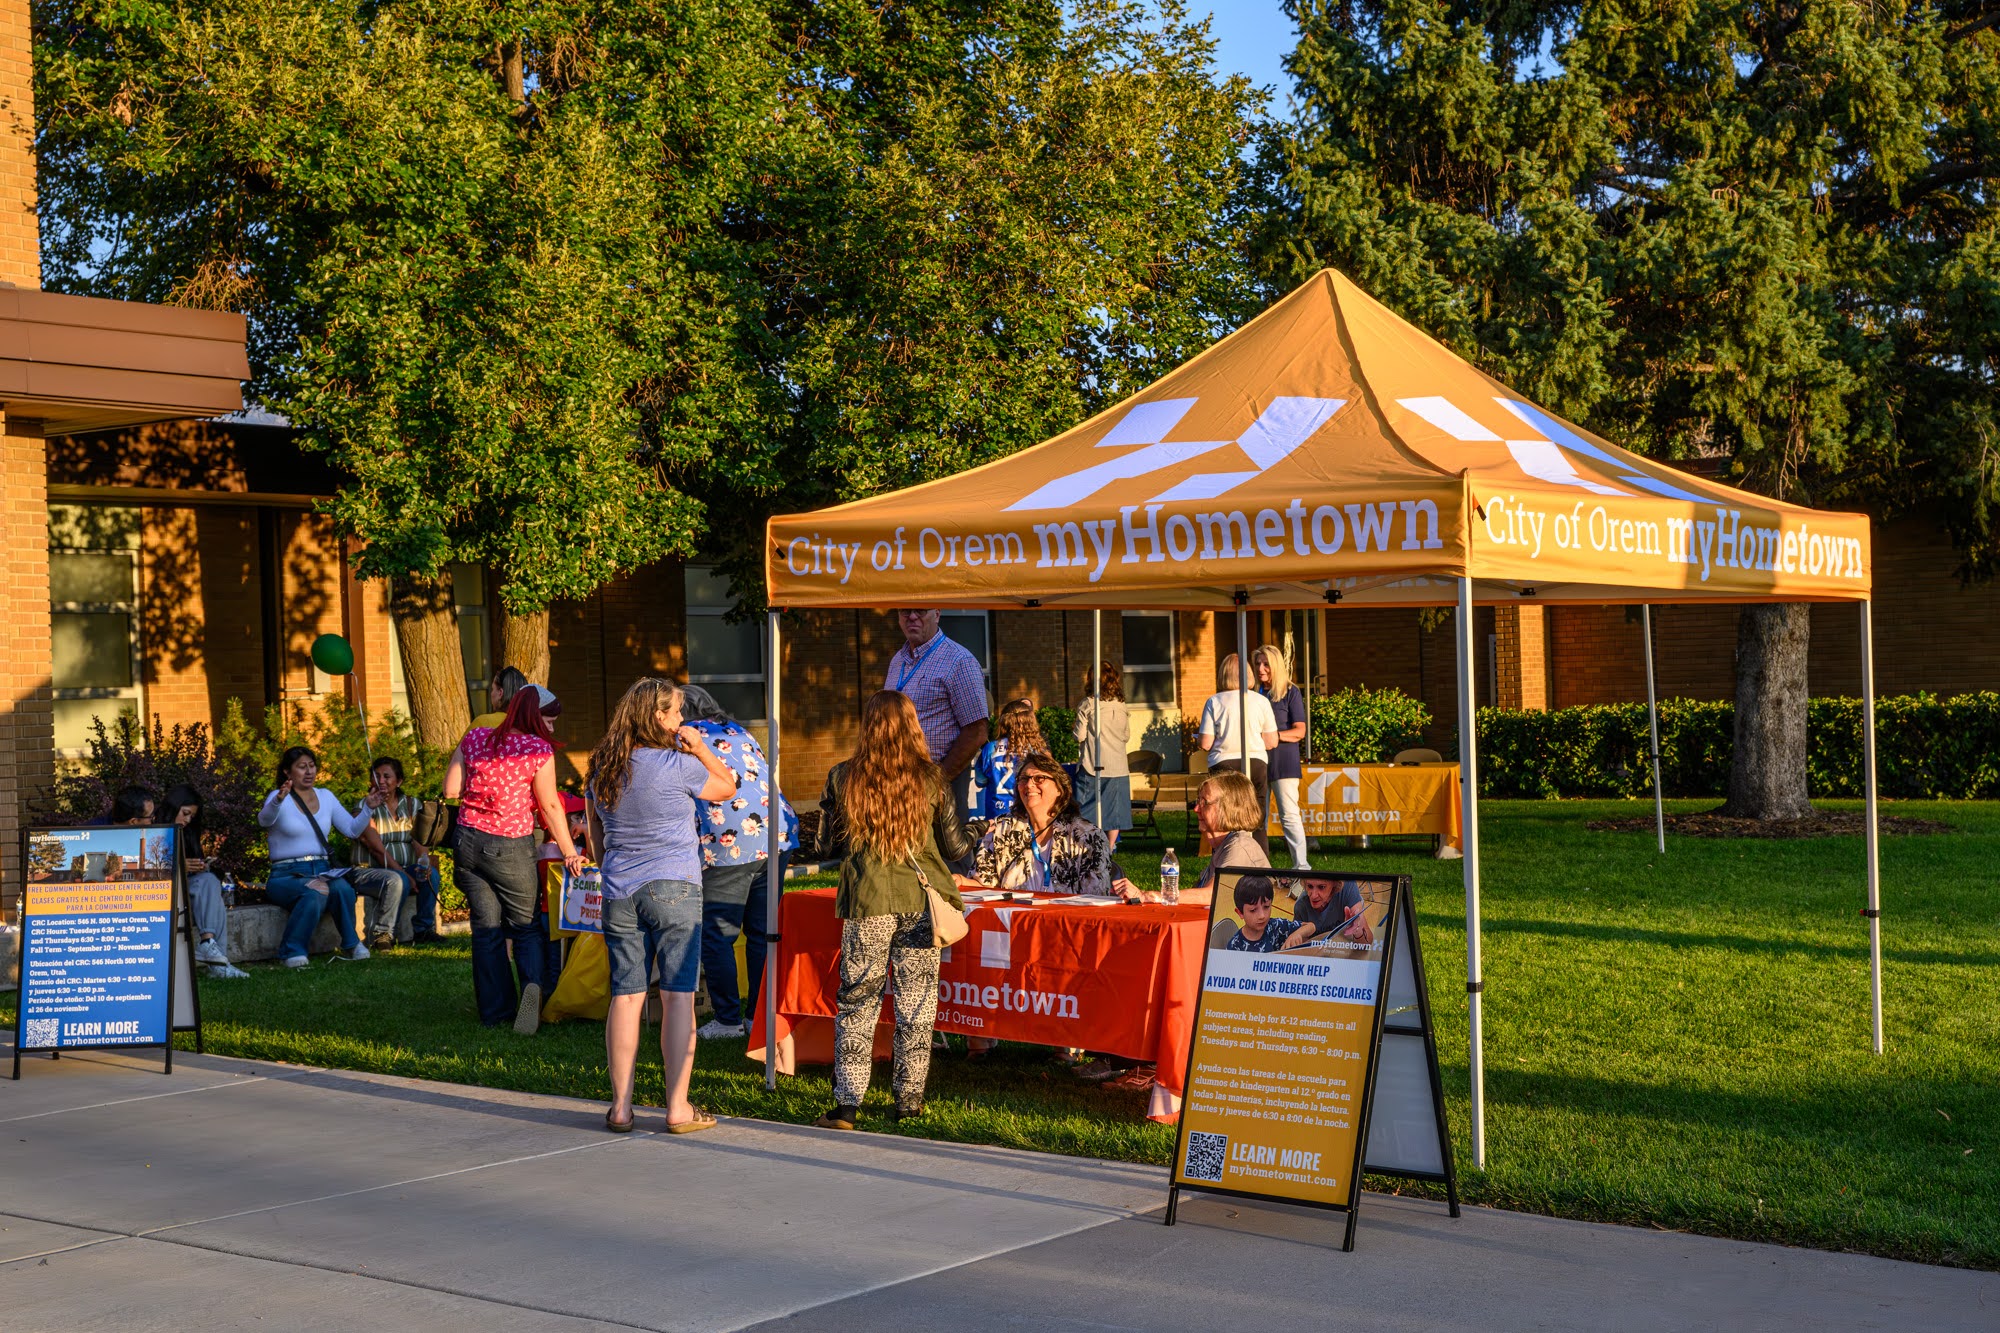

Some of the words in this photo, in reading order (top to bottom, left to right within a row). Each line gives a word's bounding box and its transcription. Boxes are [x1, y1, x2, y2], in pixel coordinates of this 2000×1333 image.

[786, 536, 862, 585] City
[871, 527, 906, 572] of
[918, 527, 1027, 568] Orem
[1033, 498, 1443, 582] myHometown
[1485, 495, 1546, 558] City
[1554, 500, 1585, 549] of
[1588, 505, 1662, 555] Orem
[1666, 508, 1863, 581] myHometown
[1272, 808, 1401, 824] Hometown
[29, 834, 80, 843] myHometown
[144, 882, 170, 890] CLASSES
[585, 893, 602, 905] HUNT
[68, 945, 103, 953] September
[1311, 938, 1371, 951] myHometown
[1253, 961, 1304, 975] HOMEWORK
[1307, 965, 1330, 977] HELP
[115, 994, 152, 1002] septiembre
[938, 976, 1081, 1020] ometown
[1207, 976, 1235, 988] AYUDA
[1239, 978, 1257, 990] CON
[1260, 980, 1276, 992] LOS
[1279, 982, 1318, 996] DEBERES
[1321, 985, 1372, 1000] ESCOLARES
[64, 1023, 101, 1036] LEARN
[106, 1021, 139, 1034] MORE
[938, 1008, 951, 1022] of
[952, 1010, 985, 1028] Orem
[1205, 1009, 1246, 1020] Homework
[1248, 1013, 1266, 1024] help
[1267, 1014, 1279, 1023] for
[1280, 1016, 1298, 1025] K-12
[1300, 1019, 1334, 1029] students
[1346, 1022, 1356, 1030] all
[64, 1036, 153, 1046] myhometownut.com
[1203, 1023, 1231, 1033] subject
[1232, 1027, 1254, 1036] areas,
[1257, 1028, 1294, 1041] including
[1296, 1032, 1327, 1044] reading.
[1202, 1036, 1238, 1048] Tuesdays
[1239, 1040, 1254, 1048] and
[1256, 1041, 1299, 1054] Thursdays,
[1302, 1046, 1318, 1055] 6:30
[1326, 1048, 1343, 1057] 8:00
[1344, 1052, 1362, 1060] p.m.
[1197, 1063, 1222, 1072] Ayuda
[1238, 1067, 1250, 1076] las
[1252, 1069, 1275, 1079] tareas
[1276, 1071, 1287, 1080] de
[1288, 1072, 1296, 1080] la
[1297, 1075, 1327, 1084] escuela
[1328, 1078, 1346, 1086] para
[1195, 1076, 1228, 1087] alumnos
[1229, 1080, 1238, 1088] de
[1240, 1080, 1290, 1094] kindergarten
[1292, 1087, 1299, 1095] al
[1316, 1090, 1339, 1099] grado
[1193, 1090, 1214, 1099] todas
[1215, 1091, 1226, 1100] las
[1228, 1095, 1263, 1105] materias,
[1265, 1097, 1309, 1110] incluyendo
[1310, 1102, 1318, 1111] la
[1320, 1103, 1349, 1114] lectura.
[1191, 1102, 1218, 1113] Martes
[1219, 1107, 1224, 1115] y
[1225, 1107, 1250, 1117] jueves
[1252, 1109, 1262, 1118] de
[1263, 1111, 1279, 1120] 6:30
[1286, 1114, 1303, 1123] 8:00
[1304, 1116, 1314, 1124] de
[1315, 1116, 1323, 1126] la
[1324, 1120, 1350, 1128] noche.
[1232, 1143, 1276, 1165] LEARN
[1280, 1149, 1321, 1171] MORE
[1229, 1165, 1336, 1186] myhometownut.com
